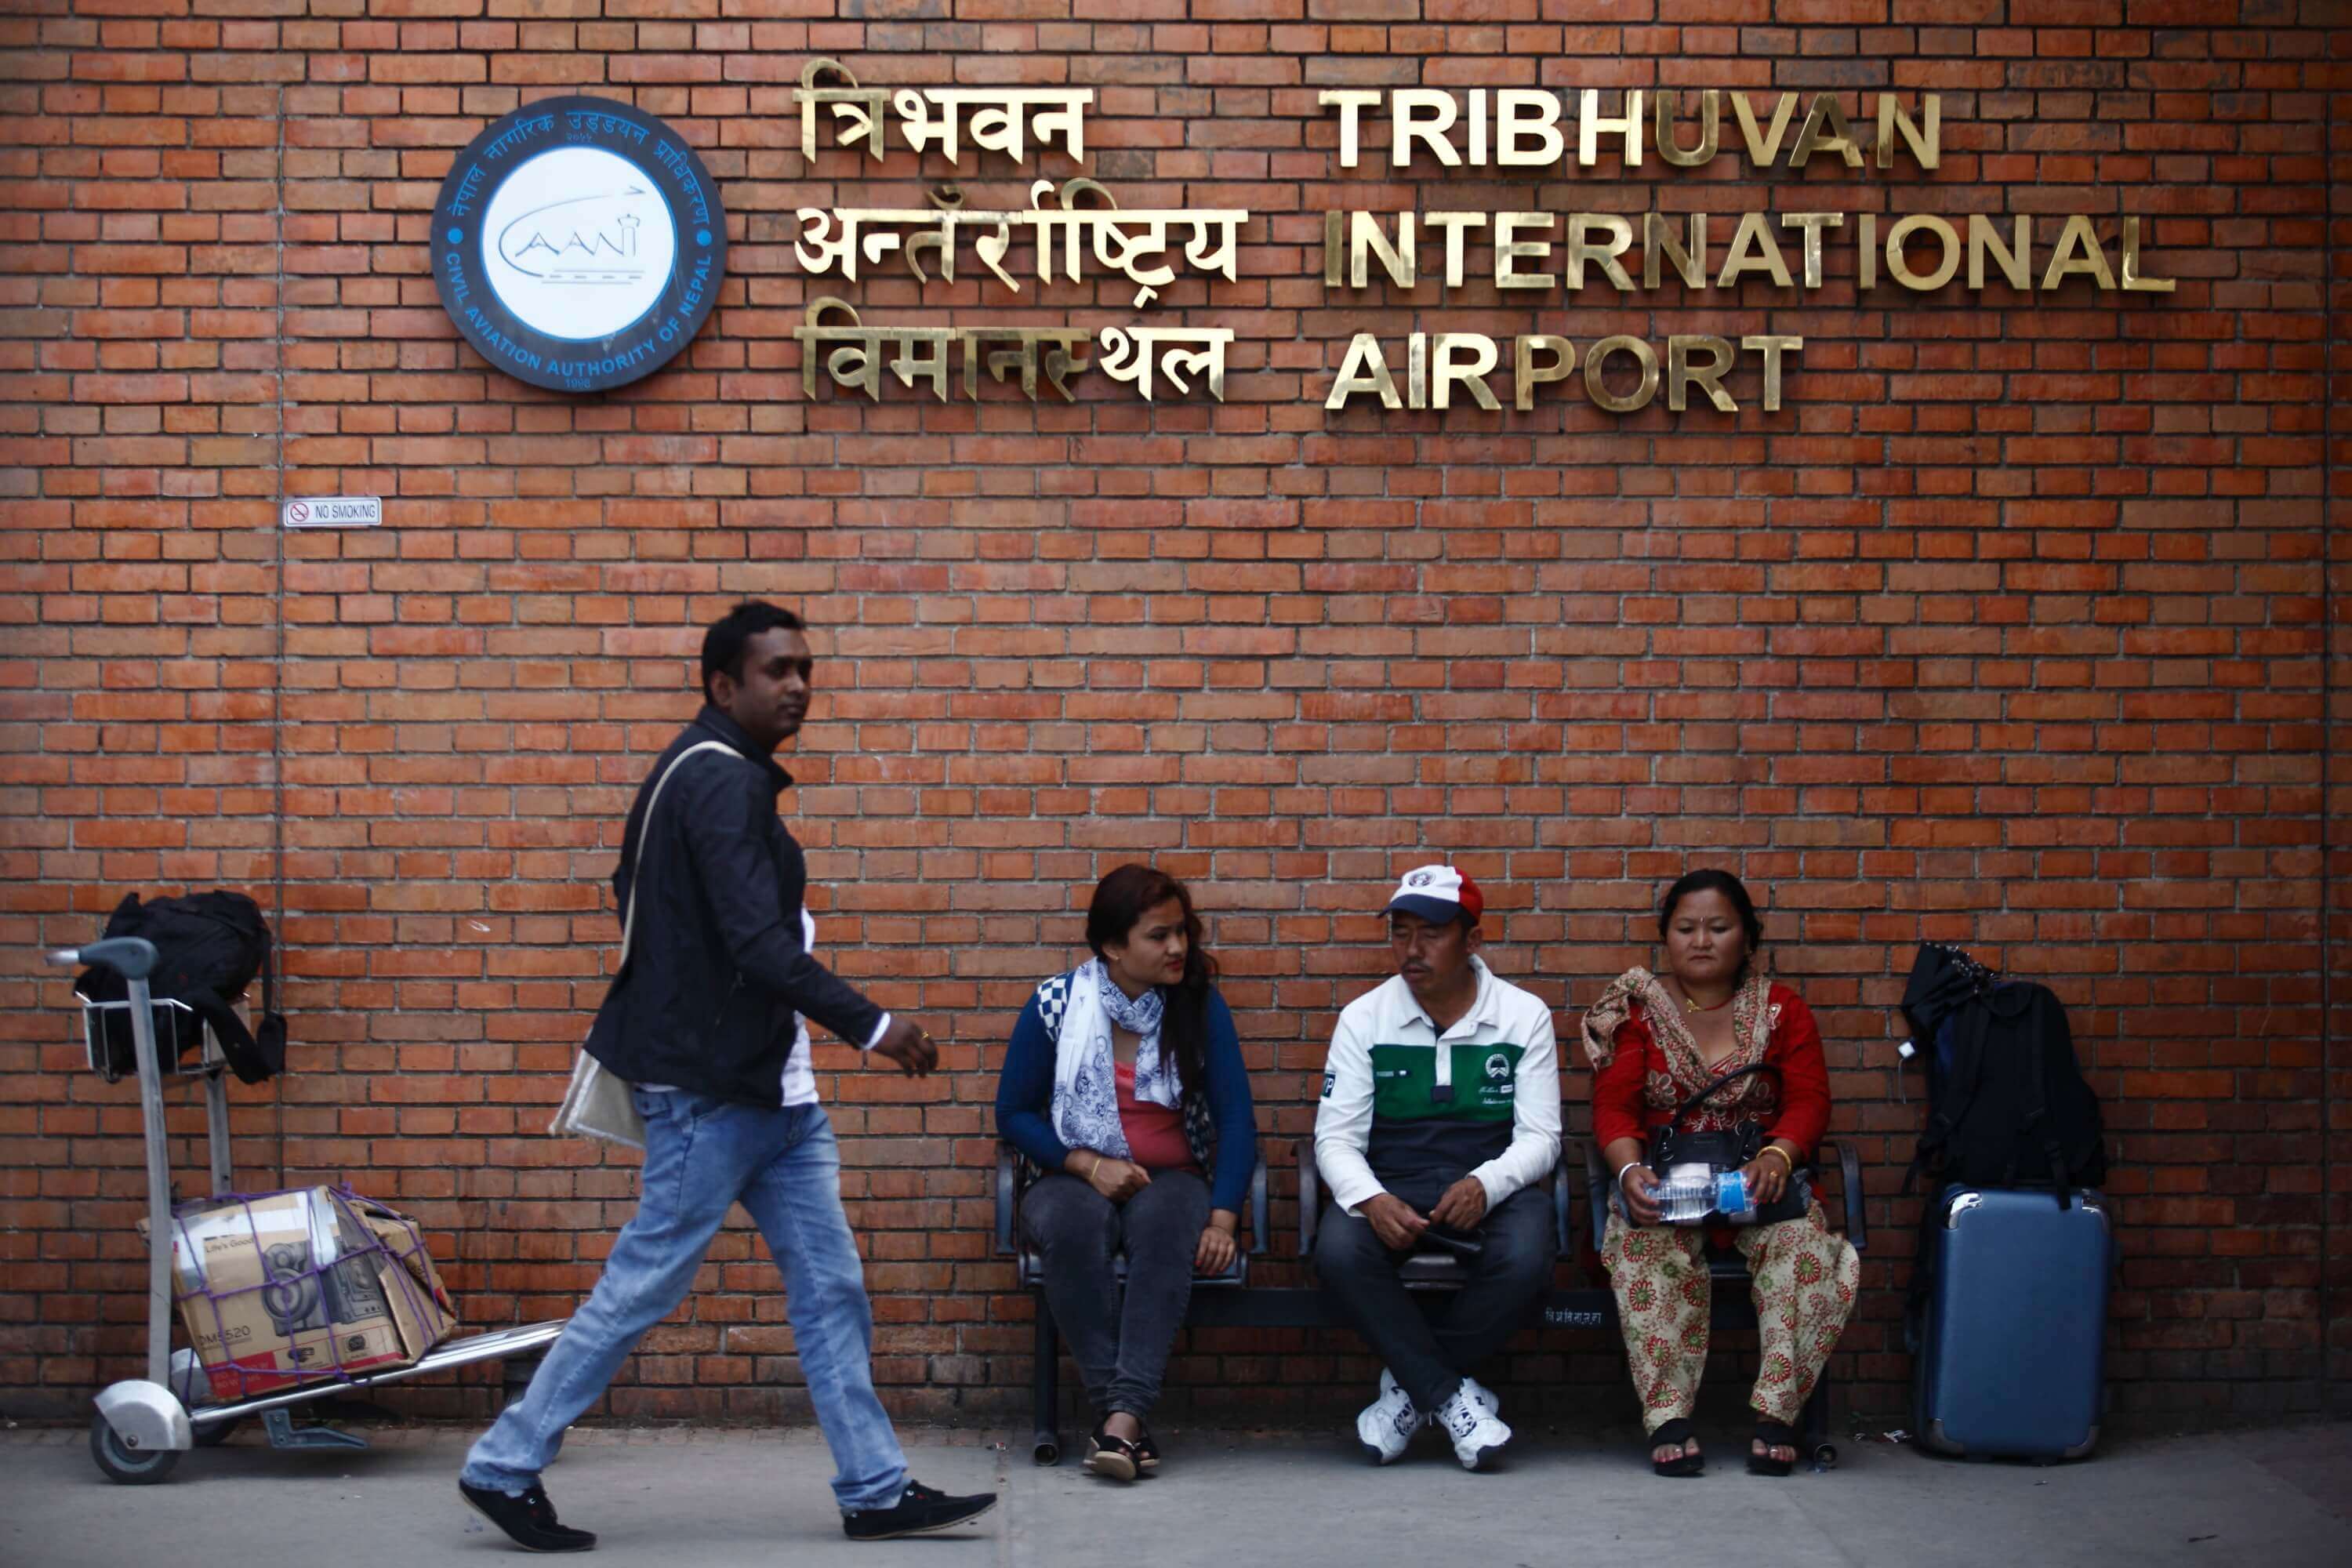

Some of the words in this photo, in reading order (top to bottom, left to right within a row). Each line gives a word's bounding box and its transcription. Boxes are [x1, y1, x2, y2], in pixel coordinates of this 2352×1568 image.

[446, 163, 487, 217] नेपाल
[483, 114, 554, 159] नागरिक
[654, 139, 710, 225] प्राधिकरण
[1319, 88, 1941, 170] TRIBHUVAN
[1324, 209, 2176, 292] INTERNATIONAL
[446, 252, 470, 305] CIVIL
[464, 307, 542, 370] AVIATION
[547, 338, 656, 377] AUTHORITY
[658, 316, 681, 342] OF
[678, 255, 712, 318] NEPAL
[793, 296, 1236, 403] विमानस्थल
[1324, 332, 1804, 412] AIRPORT
[315, 506, 329, 518] NO
[332, 504, 376, 518] SMOKING
